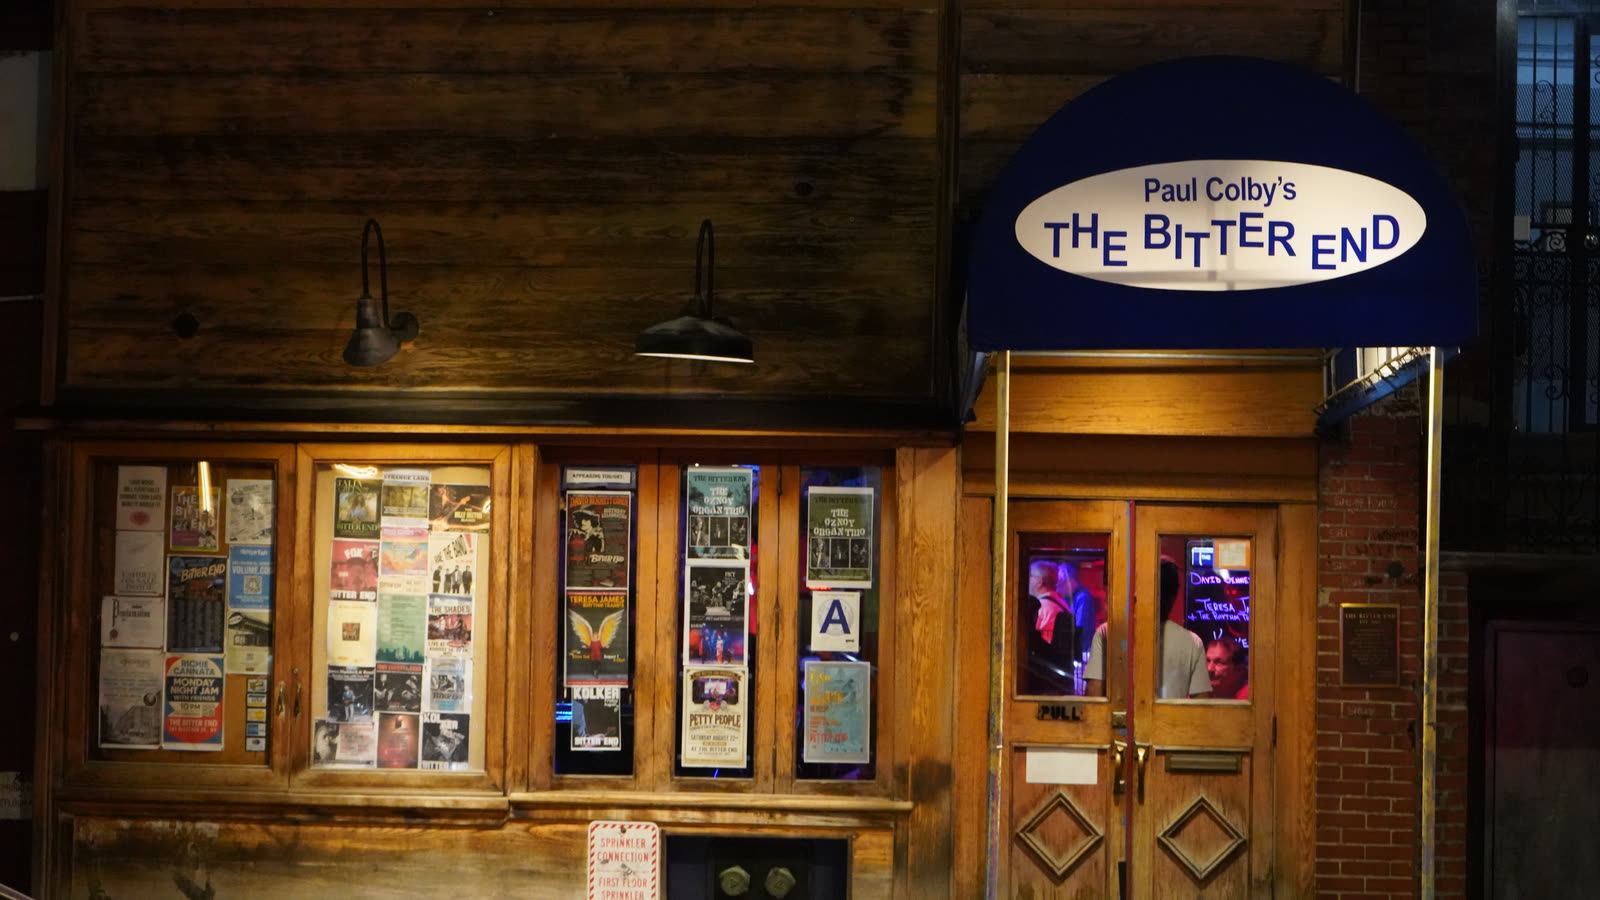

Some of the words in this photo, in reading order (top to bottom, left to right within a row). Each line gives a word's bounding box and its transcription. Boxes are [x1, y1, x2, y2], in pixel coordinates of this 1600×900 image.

[1144, 177, 1197, 203] Paul
[1206, 176, 1297, 207] Colby's
[1044, 212, 1128, 267] THE
[1144, 211, 1296, 268] BITTER
[1311, 213, 1401, 271] END
[710, 487, 728, 496] THE
[176, 494, 198, 506] THE
[692, 505, 724, 515] ORGAN
[723, 505, 745, 515] TRIO
[831, 509, 849, 518] THE
[191, 518, 215, 531] END
[813, 528, 844, 537] ORGAN
[844, 528, 866, 537] TRIO
[208, 563, 226, 577] END
[1190, 572, 1221, 585] DAVID
[570, 595, 598, 603] TERESA
[599, 595, 625, 603] JAMES
[444, 605, 470, 613] SHADES
[1194, 598, 1236, 613] TERESA
[819, 599, 851, 635] A
[1197, 610, 1211, 620] THE
[1211, 610, 1240, 621] RHYTHM
[173, 667, 215, 675] CANNATA
[173, 678, 215, 687] MONDAY
[170, 686, 198, 695] NIGHT
[199, 687, 219, 696] JAM
[573, 687, 619, 700] KOLKER
[1041, 705, 1080, 721] PULL
[690, 714, 713, 728] PETTY
[715, 714, 741, 728] PEOPLE
[603, 737, 619, 747] END
[600, 838, 646, 848] SPRINKLER
[597, 851, 649, 862] CONNECTION
[598, 877, 619, 887] FIRST
[622, 877, 648, 887] FLOOR
[601, 891, 644, 900] SPRINKLER
